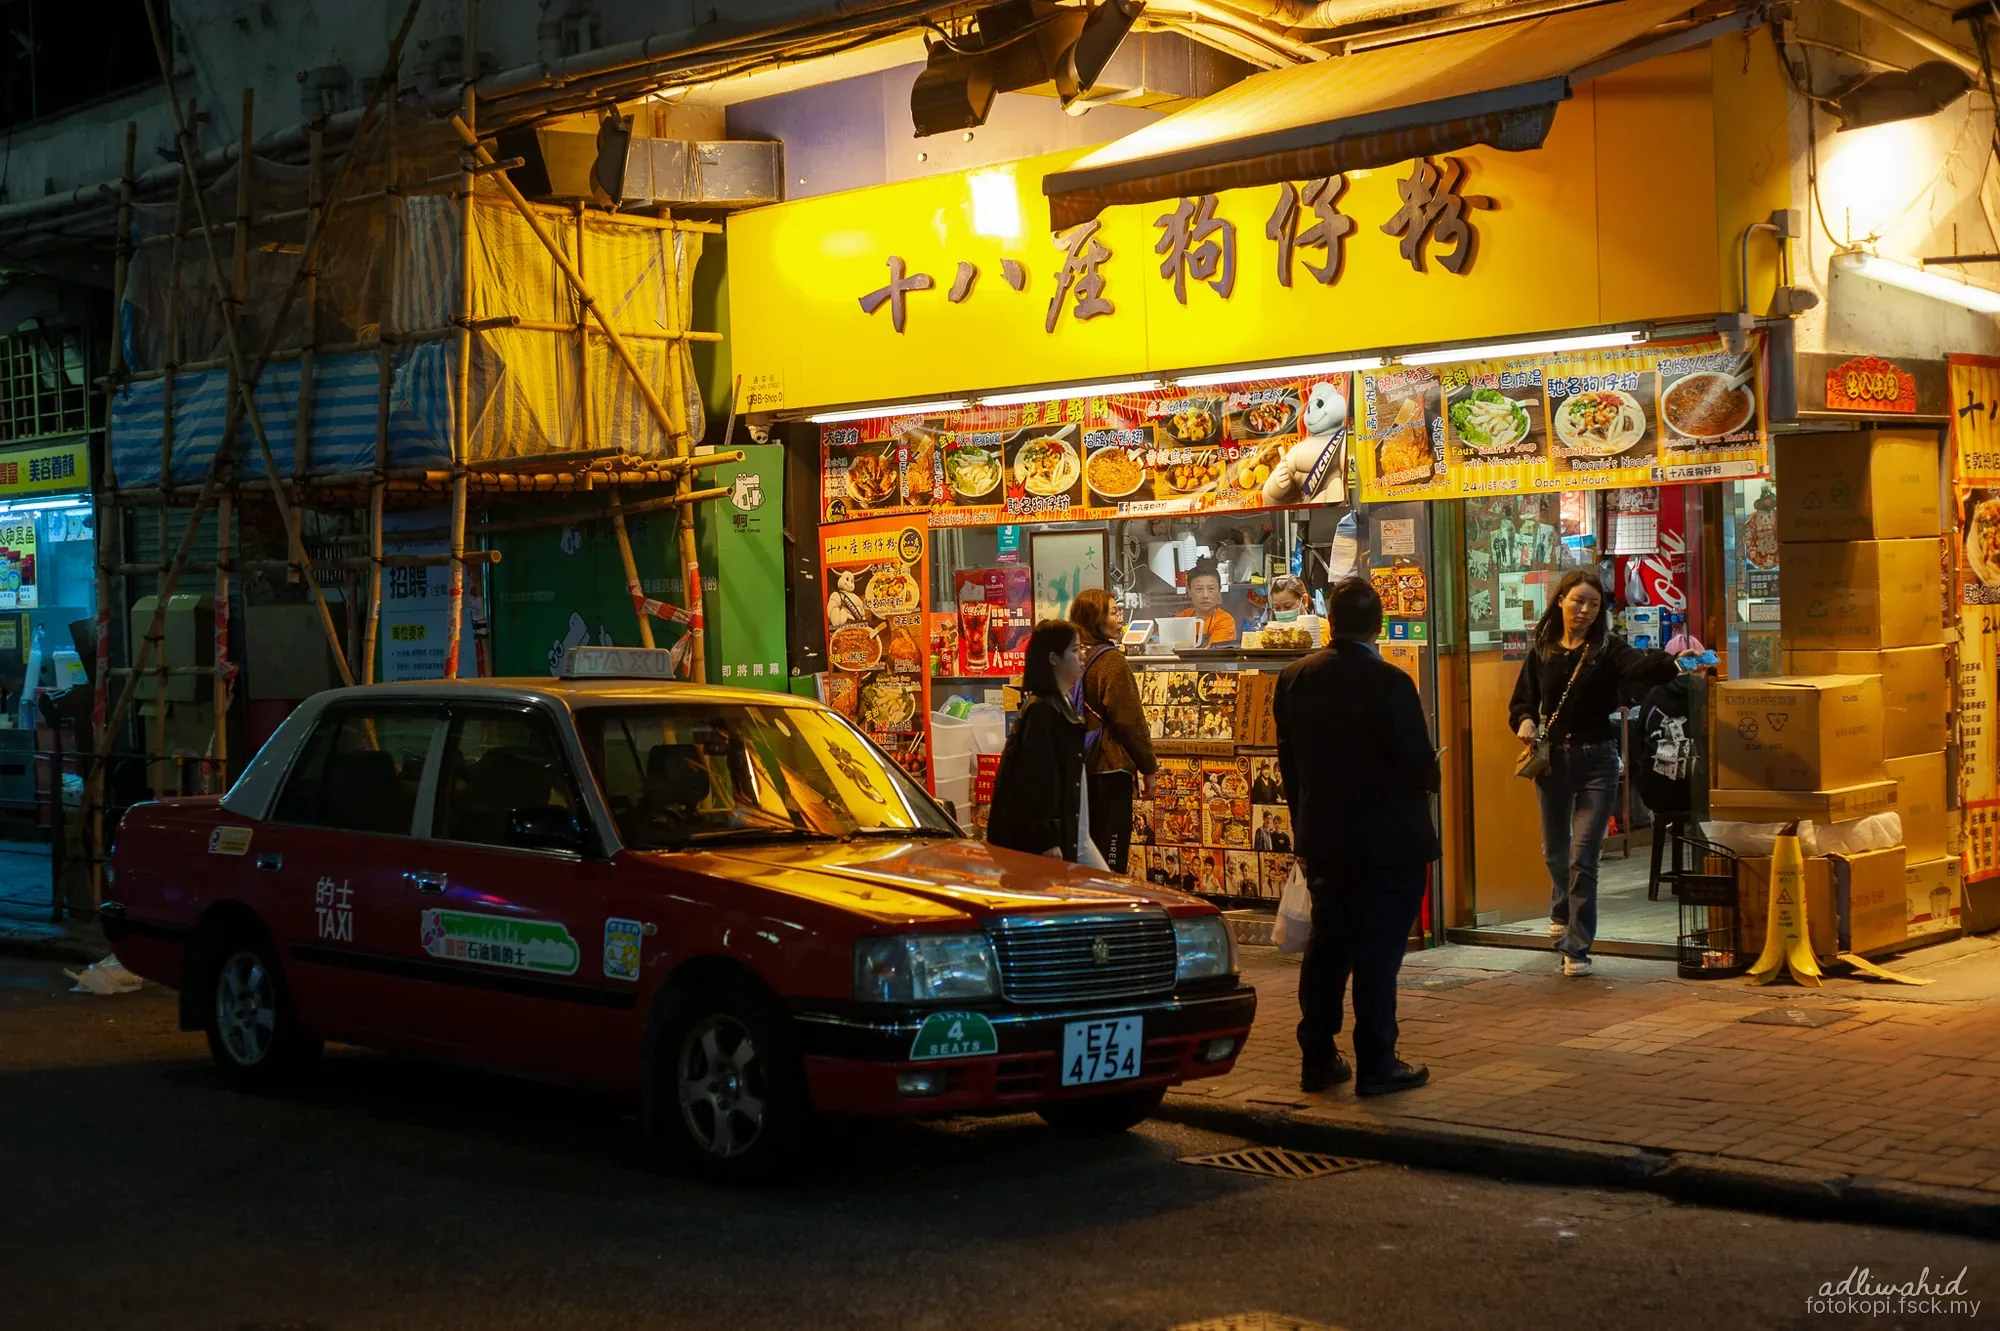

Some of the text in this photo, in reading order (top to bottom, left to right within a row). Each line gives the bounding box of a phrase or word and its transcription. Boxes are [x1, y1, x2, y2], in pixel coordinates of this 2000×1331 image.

[857, 155, 1500, 335] 十八座狗仔粉
[1547, 372, 1640, 397] 馳名狗仔粉
[1022, 397, 1109, 426] 恭喜發財
[1451, 446, 1475, 456] Faux
[1513, 442, 1537, 453] Soup
[1550, 446, 1602, 458] Signature
[1464, 454, 1548, 468] with Minced Dace
[1572, 457, 1618, 472] Doggie's
[1534, 474, 1610, 489] Open 24 Hours
[1008, 495, 1071, 514] 馳名狗仔粉
[826, 537, 898, 555] 十八座狗仔粉
[583, 650, 667, 673] TAXI
[722, 663, 780, 677] 即將開幕
[315, 876, 355, 909] 的士
[314, 908, 354, 942] TAXI
[467, 941, 526, 966] 石油氣的士
[947, 1020, 964, 1041] 4
[1087, 1021, 1120, 1052] EZ
[929, 1040, 981, 1056] SEATS
[1068, 1047, 1135, 1082] 4754
